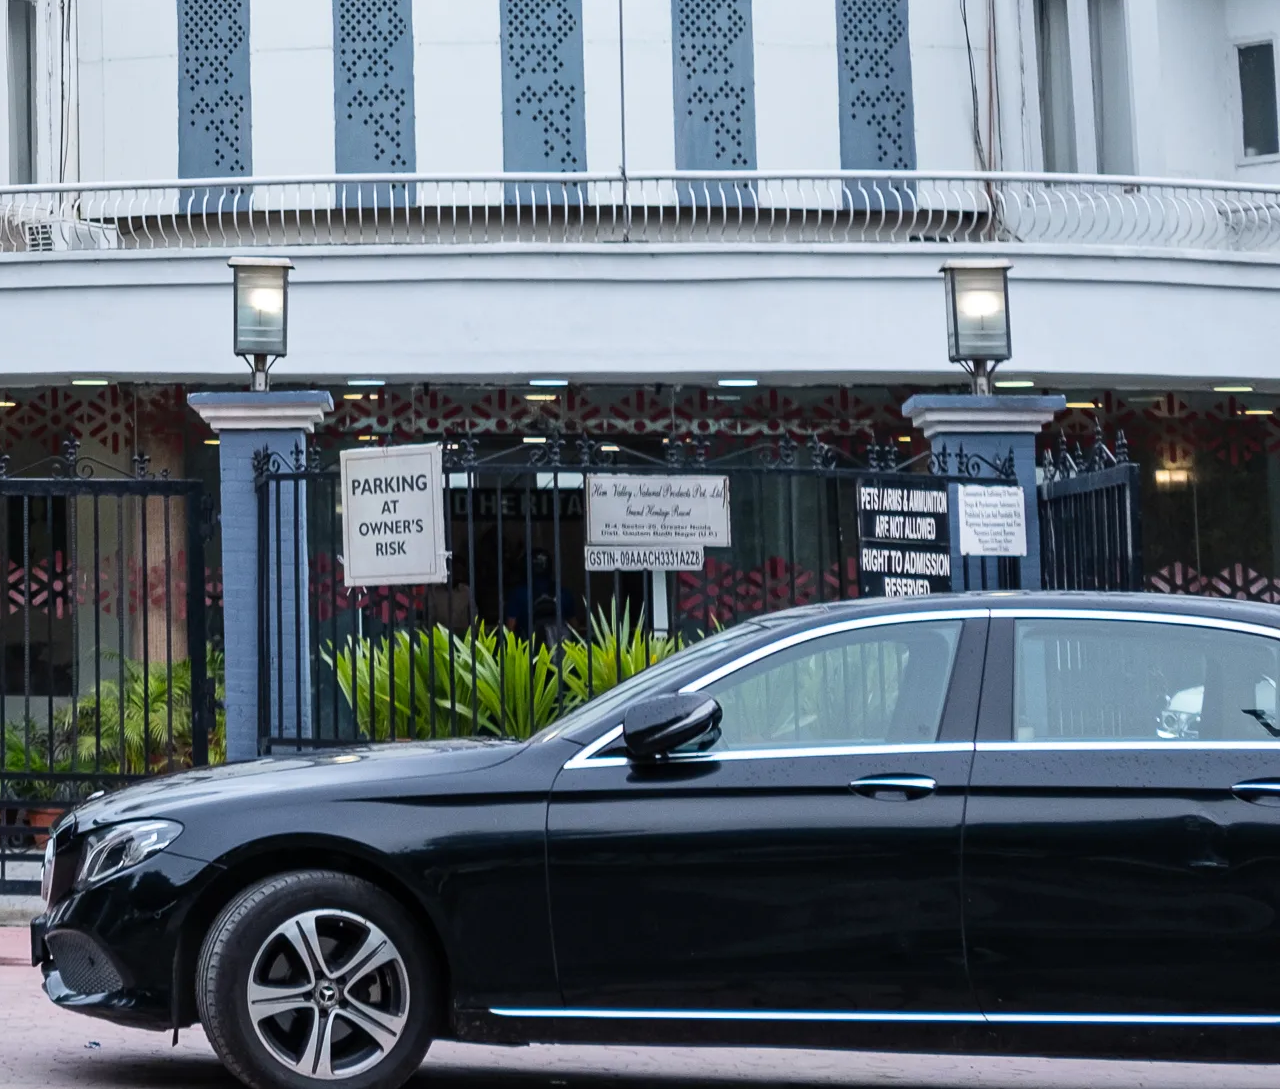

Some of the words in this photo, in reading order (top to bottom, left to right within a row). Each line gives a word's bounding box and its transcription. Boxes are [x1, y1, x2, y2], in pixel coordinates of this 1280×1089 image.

[351, 474, 428, 496] PARKING
[612, 482, 633, 502] Valley
[633, 482, 662, 498] Natural
[662, 482, 691, 499] Products
[381, 500, 400, 515] AT
[861, 487, 879, 510] PETS
[883, 488, 903, 511] ARMS
[903, 489, 909, 512] &
[909, 489, 948, 514] AMMUNITION
[358, 519, 424, 537] OWNER'S
[875, 515, 890, 537] ARE
[890, 516, 904, 539] NOT
[905, 517, 936, 540] ALLOWED
[375, 541, 407, 557] RISK
[862, 548, 889, 573] RIGHT
[891, 550, 903, 573] TO
[904, 551, 950, 577] ADMISSION
[884, 576, 931, 598] RESERVED
